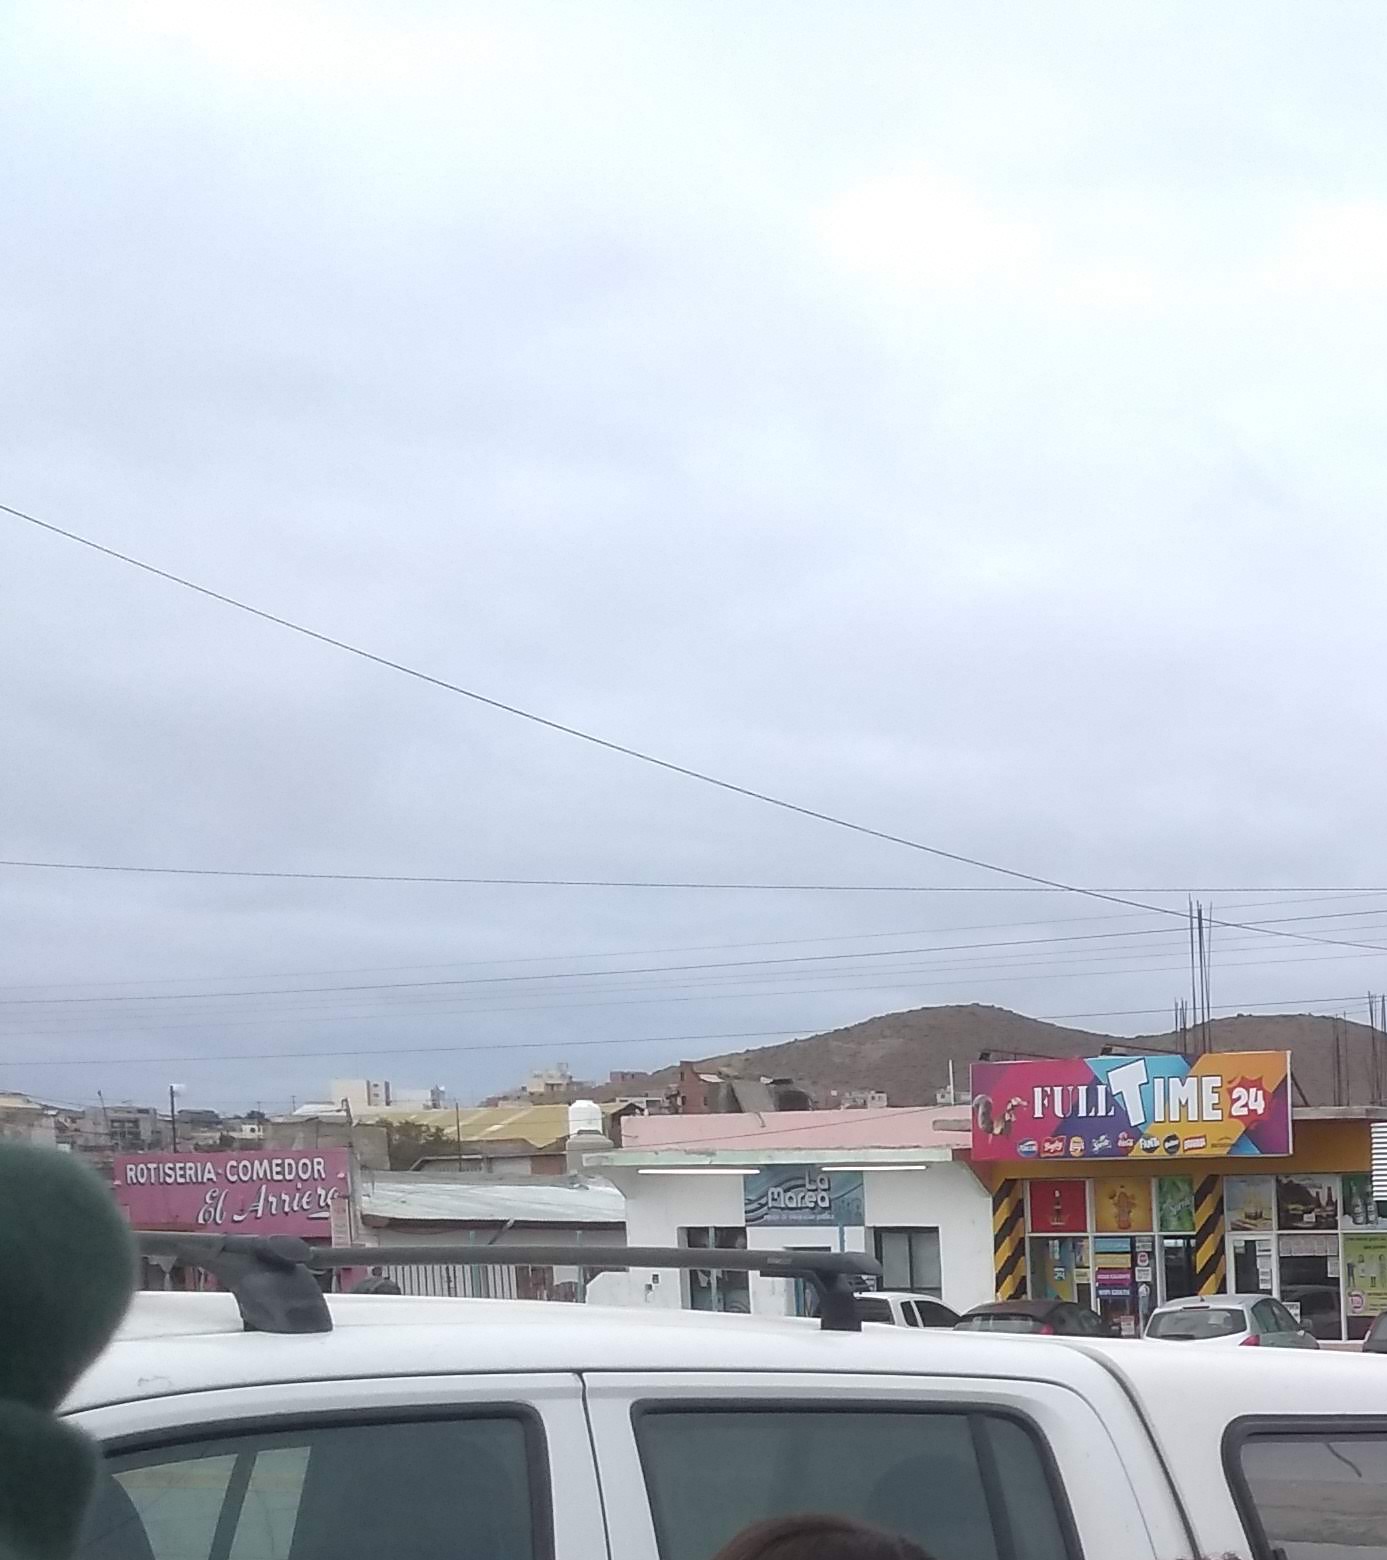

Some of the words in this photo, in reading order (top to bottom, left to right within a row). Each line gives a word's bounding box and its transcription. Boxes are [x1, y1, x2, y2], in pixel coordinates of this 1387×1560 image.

[1032, 1085, 1116, 1118] FULL
[1107, 1058, 1222, 1127] TIME
[1231, 1086, 1265, 1117] 24
[225, 1156, 326, 1182] COMEDOR
[198, 1187, 229, 1225] El
[767, 1186, 830, 1208] Marea
